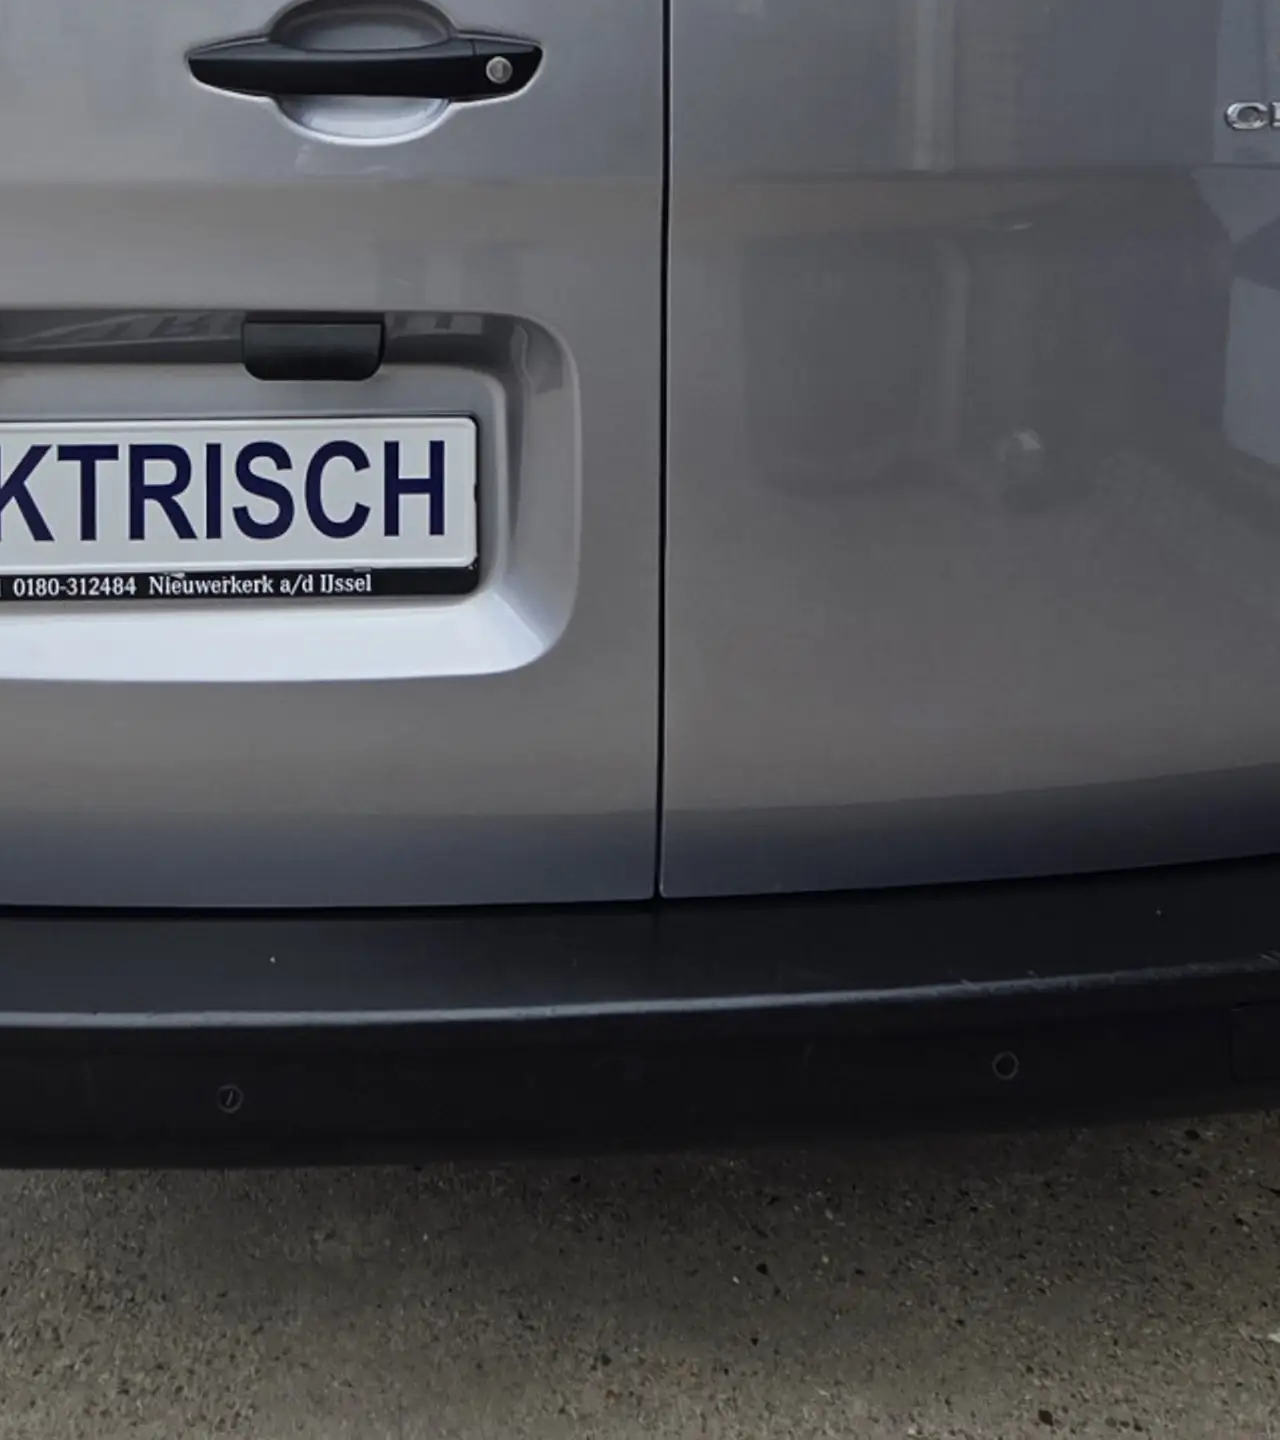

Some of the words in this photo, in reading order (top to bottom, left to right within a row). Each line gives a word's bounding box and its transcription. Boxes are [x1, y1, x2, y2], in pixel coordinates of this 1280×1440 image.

[12, 576, 137, 598] 0180-312484
[148, 574, 274, 596] Nieuwerkerk
[279, 574, 314, 596] a/d
[320, 573, 372, 593] IJssel
